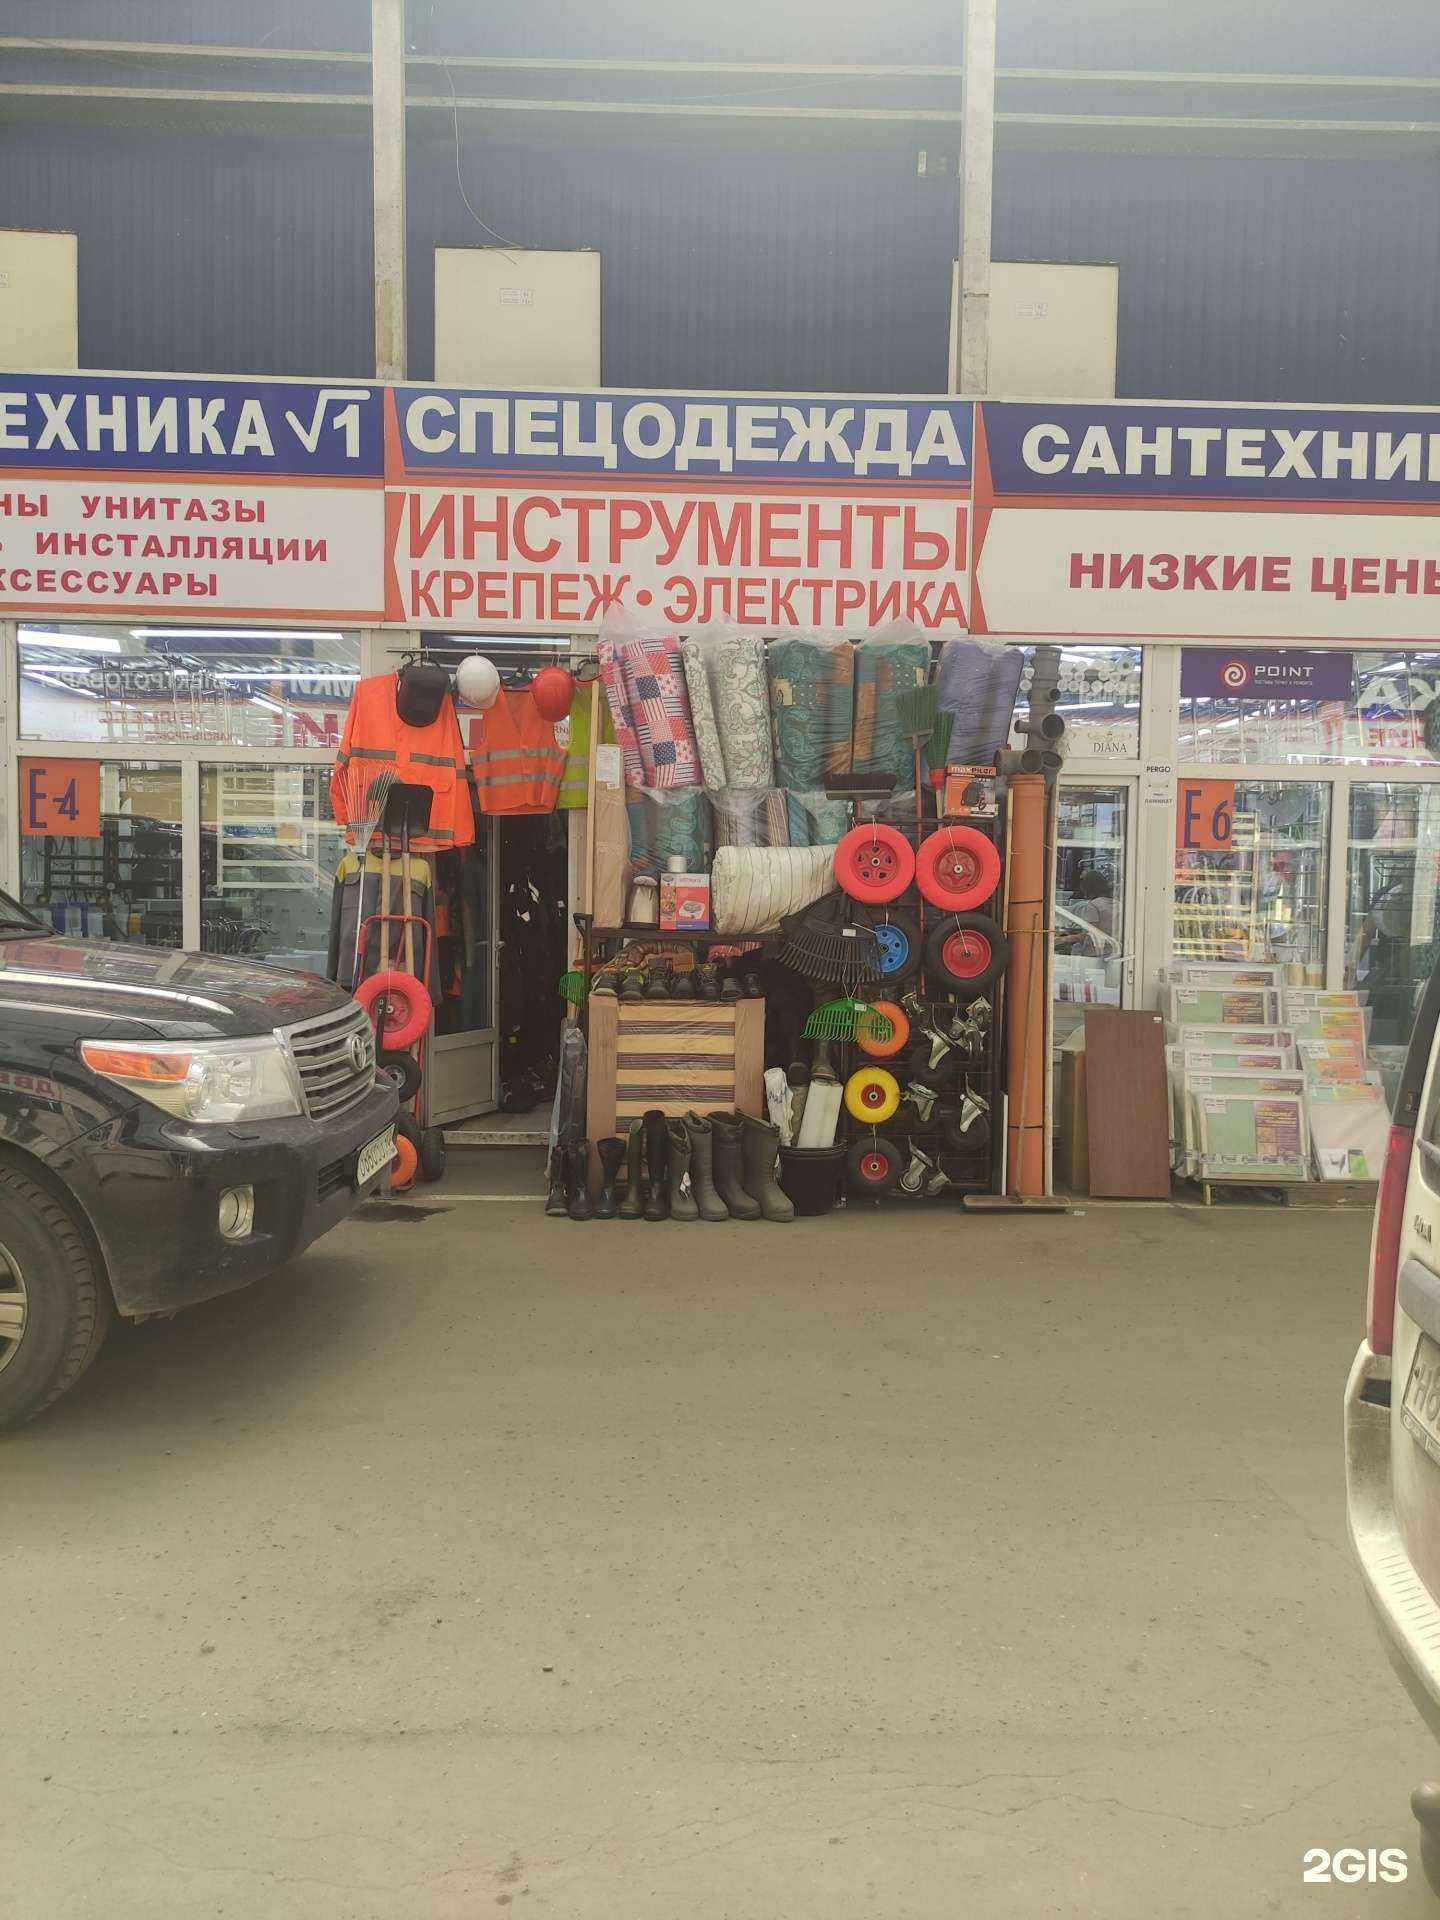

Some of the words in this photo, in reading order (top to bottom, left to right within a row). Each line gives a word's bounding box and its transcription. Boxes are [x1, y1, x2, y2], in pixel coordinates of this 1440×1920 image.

[0, 393, 276, 457] ЕХНИКА
[405, 395, 966, 475] СПЕЦОДЕЖДА
[81, 495, 266, 524] УНИТАЗЫ
[35, 532, 328, 565] ИНСТАЛЛЯЦИИ
[409, 494, 967, 570] ИНСТРУМЕНТЫ
[1069, 552, 1292, 592] НИЗКИЕ
[411, 569, 630, 622] КРЕПЕЖ
[662, 575, 969, 628] ЭЛЕКТРИКА
[1254, 666, 1314, 678] POINT
[1093, 743, 1127, 753] DIANA
